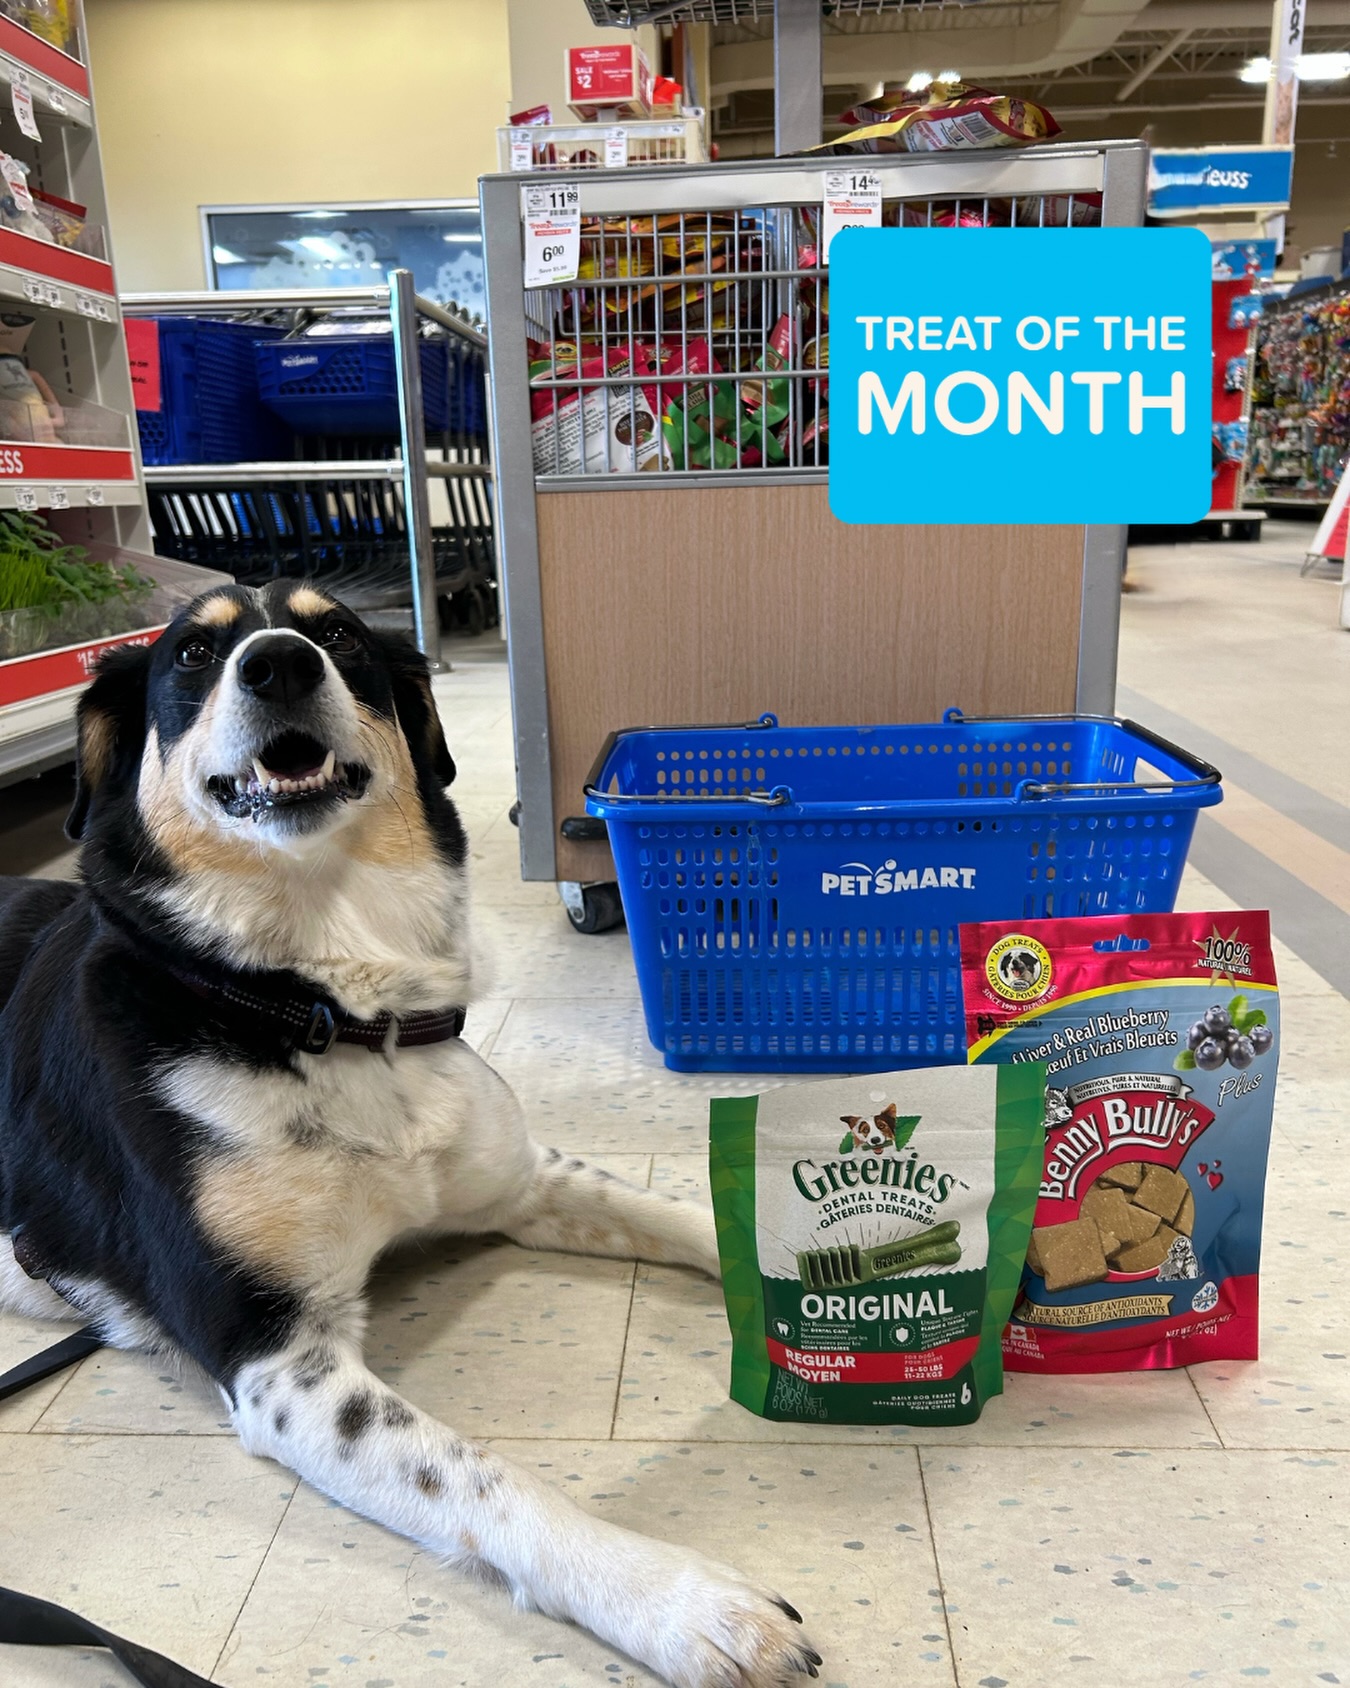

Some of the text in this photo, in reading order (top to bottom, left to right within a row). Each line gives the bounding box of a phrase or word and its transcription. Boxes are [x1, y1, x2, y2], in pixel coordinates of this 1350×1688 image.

[822, 862, 976, 896] PETSMART
[992, 938, 1043, 956] DOG TREATS
[1206, 936, 1251, 966] 100%
[1016, 988, 1039, 1000] POUR
[1037, 964, 1050, 990] CHIEN
[982, 988, 1002, 1006] SINCE
[1023, 997, 1047, 1011] DEPUIS
[1053, 1033, 1066, 1050] &
[1065, 1017, 1096, 1046] Real
[1098, 1008, 1169, 1034] Blueberry
[1045, 1031, 1178, 1075] œuf Et Vrais Bleuets
[1113, 1083, 1132, 1092] PURES
[1218, 1072, 1263, 1107] Plus
[1039, 1098, 1199, 1200] Benny Bully's
[792, 1152, 957, 1204] Greenies
[822, 1191, 934, 1214] DENTAL TREATS
[819, 1204, 936, 1229] GÂTERIES DENTAIRES
[874, 1250, 917, 1270] Greenies
[801, 1289, 954, 1321] ORIGINAL
[1062, 1306, 1094, 1317] SOURCE
[1094, 1306, 1105, 1314] OF
[1104, 1297, 1163, 1312] ANTIOXIDANTS
[1055, 1313, 1099, 1325] NATURELLE
[1017, 1341, 1039, 1351] CANADA
[1023, 1350, 1044, 1359] CANADA
[785, 1348, 856, 1368] REGULAR
[904, 1365, 928, 1373] 25-50
[778, 1369, 794, 1386] NET
[787, 1361, 840, 1382] MOYEN
[772, 1395, 779, 1409] 6
[775, 1381, 824, 1408] POIDS NET
[961, 1382, 972, 1405] 6
